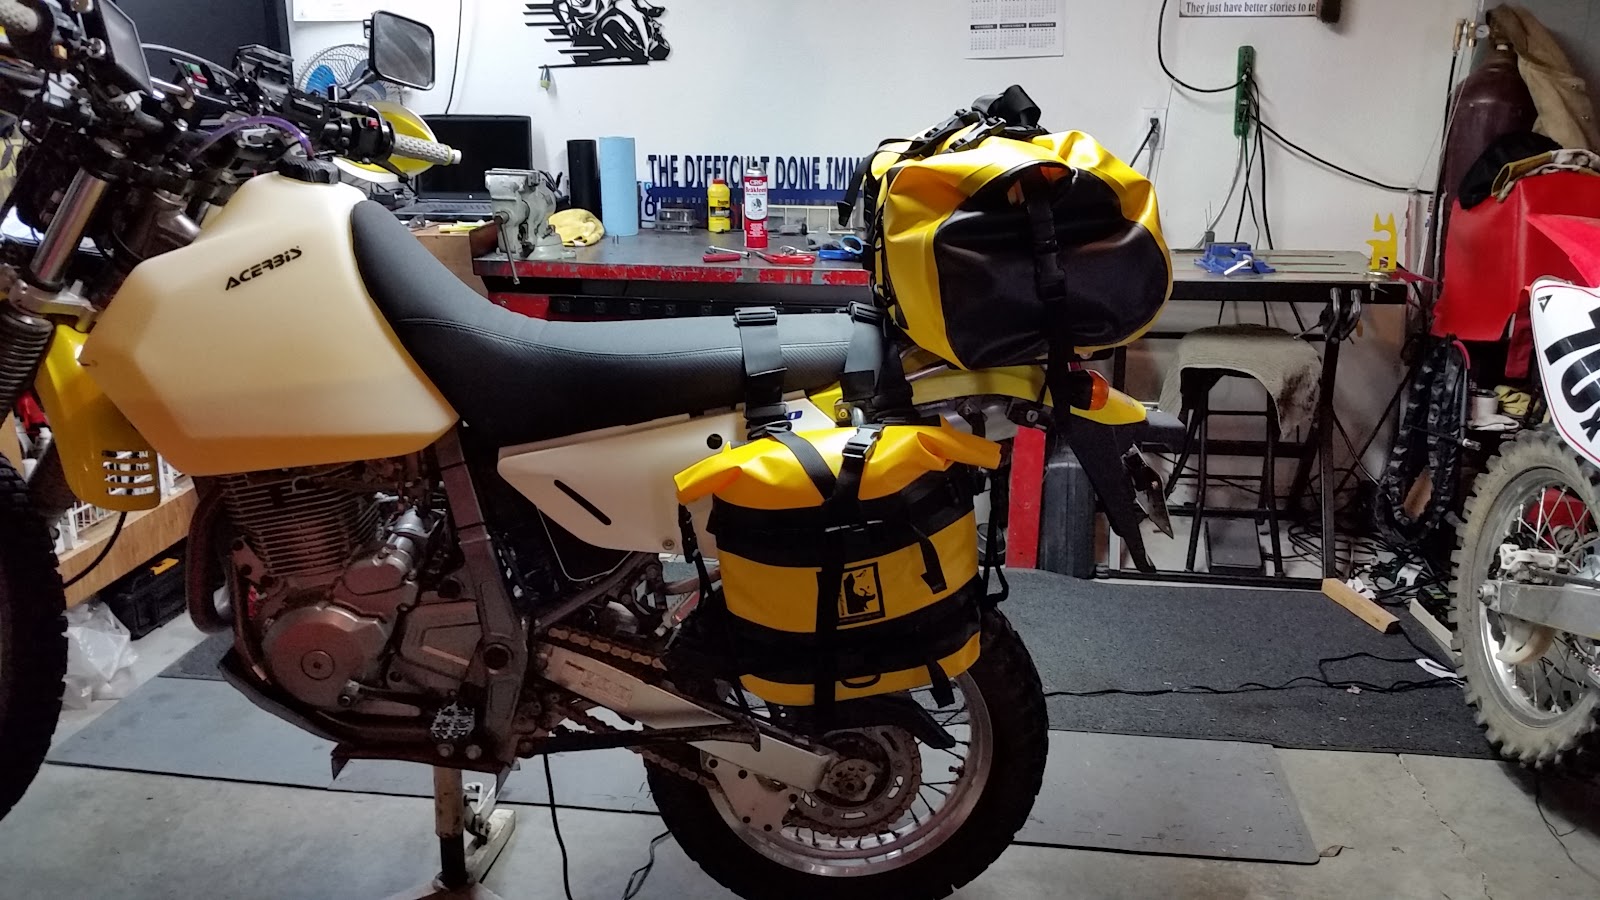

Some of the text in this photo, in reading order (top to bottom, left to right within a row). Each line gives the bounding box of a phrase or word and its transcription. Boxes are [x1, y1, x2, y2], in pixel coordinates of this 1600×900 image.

[1186, 1, 1317, 14] They just have better stories to te
[648, 154, 866, 191] THE DIFFICUT DONE IMM
[225, 245, 302, 291] ACERBIS
